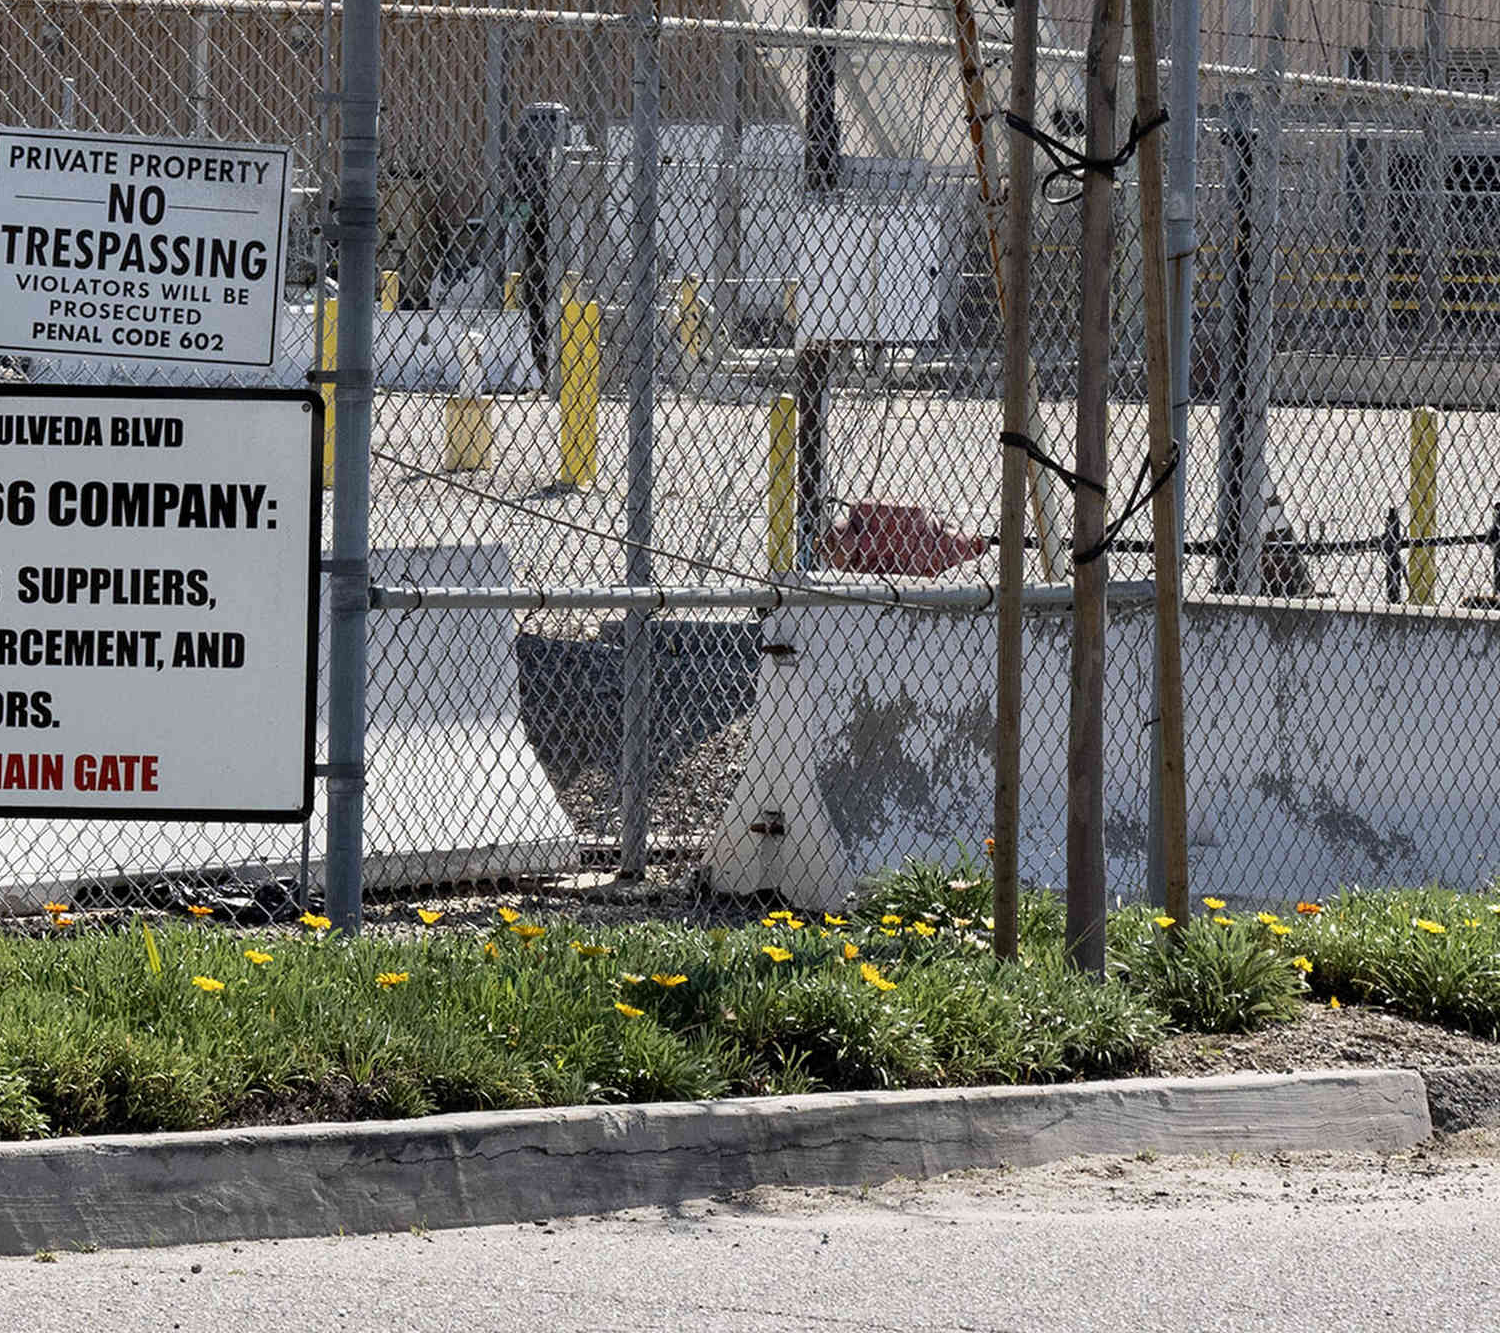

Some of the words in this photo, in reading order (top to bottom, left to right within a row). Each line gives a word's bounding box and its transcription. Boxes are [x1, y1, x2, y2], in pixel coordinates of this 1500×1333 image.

[9, 146, 117, 174] PRIVATE
[129, 153, 269, 184] PROPERTY
[107, 183, 166, 225] NO
[1, 225, 267, 281] TRESPASSING
[16, 274, 149, 298] VIOLATORS
[161, 283, 211, 302] WILL
[223, 288, 248, 305] BE
[49, 300, 201, 325] PROSECUTED
[32, 322, 102, 343] PENAL
[112, 327, 170, 348] CODE
[179, 332, 223, 351] 602
[110, 417, 183, 447] BLVD
[48, 481, 277, 529] COMPANY:
[18, 566, 216, 610] SUPPLIERS,
[172, 632, 244, 668] AND
[74, 754, 158, 791] GATE
